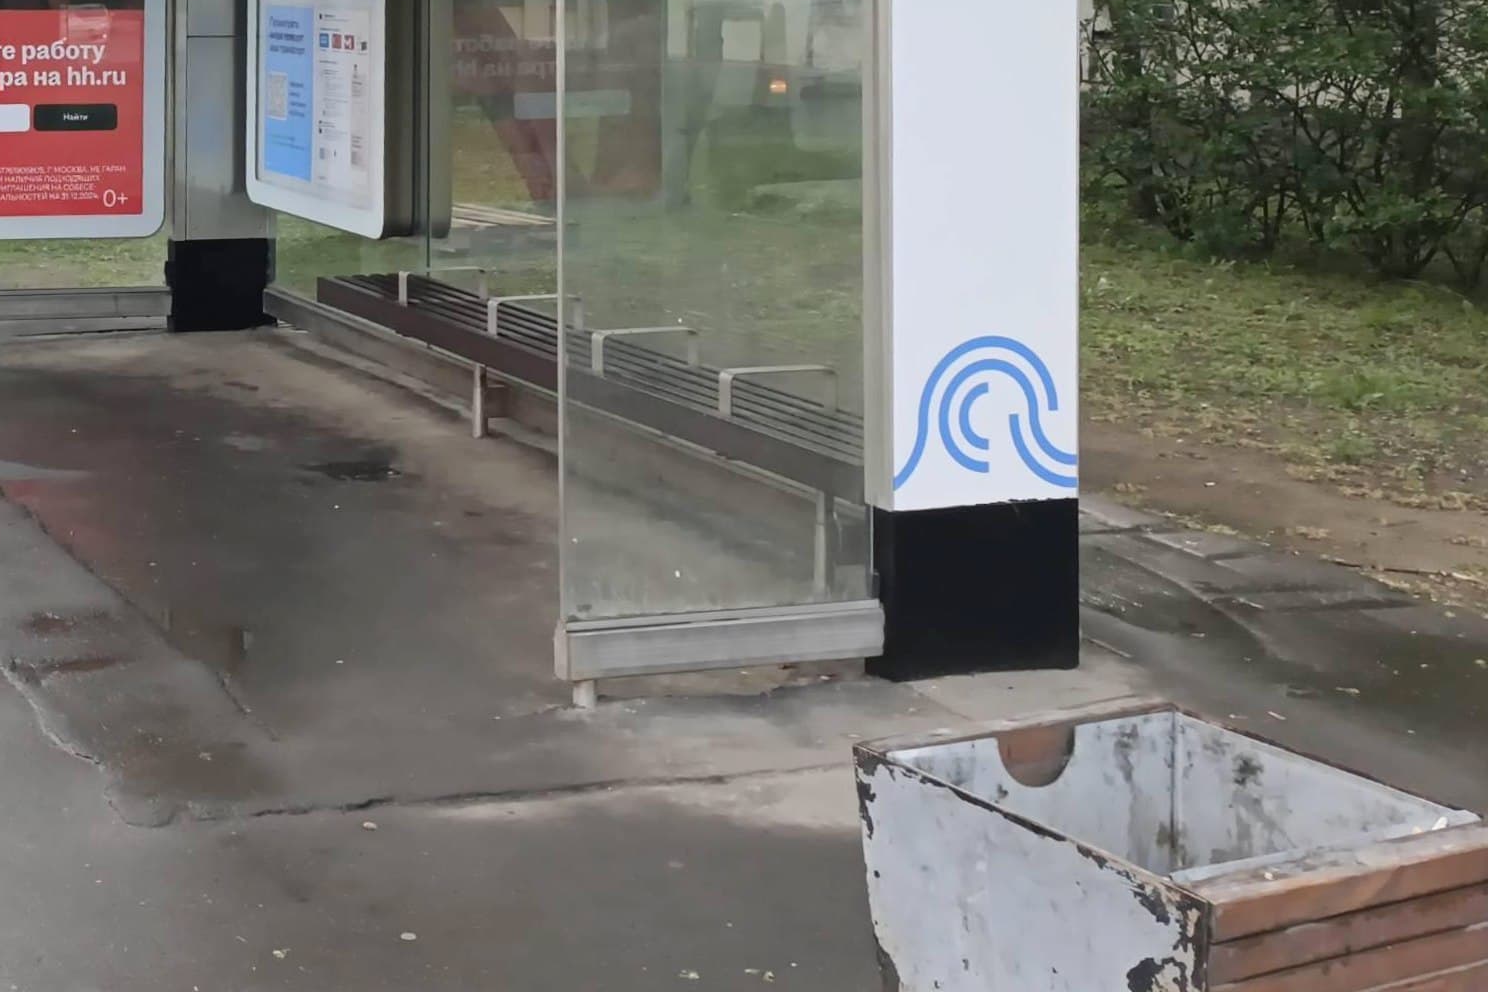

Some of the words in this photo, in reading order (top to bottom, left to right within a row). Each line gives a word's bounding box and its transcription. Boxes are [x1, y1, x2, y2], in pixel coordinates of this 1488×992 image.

[22, 40, 105, 64] работу
[34, 70, 61, 85] на
[67, 66, 126, 86] hh.ru
[63, 113, 89, 122] Найти
[103, 189, 128, 207] 0+
